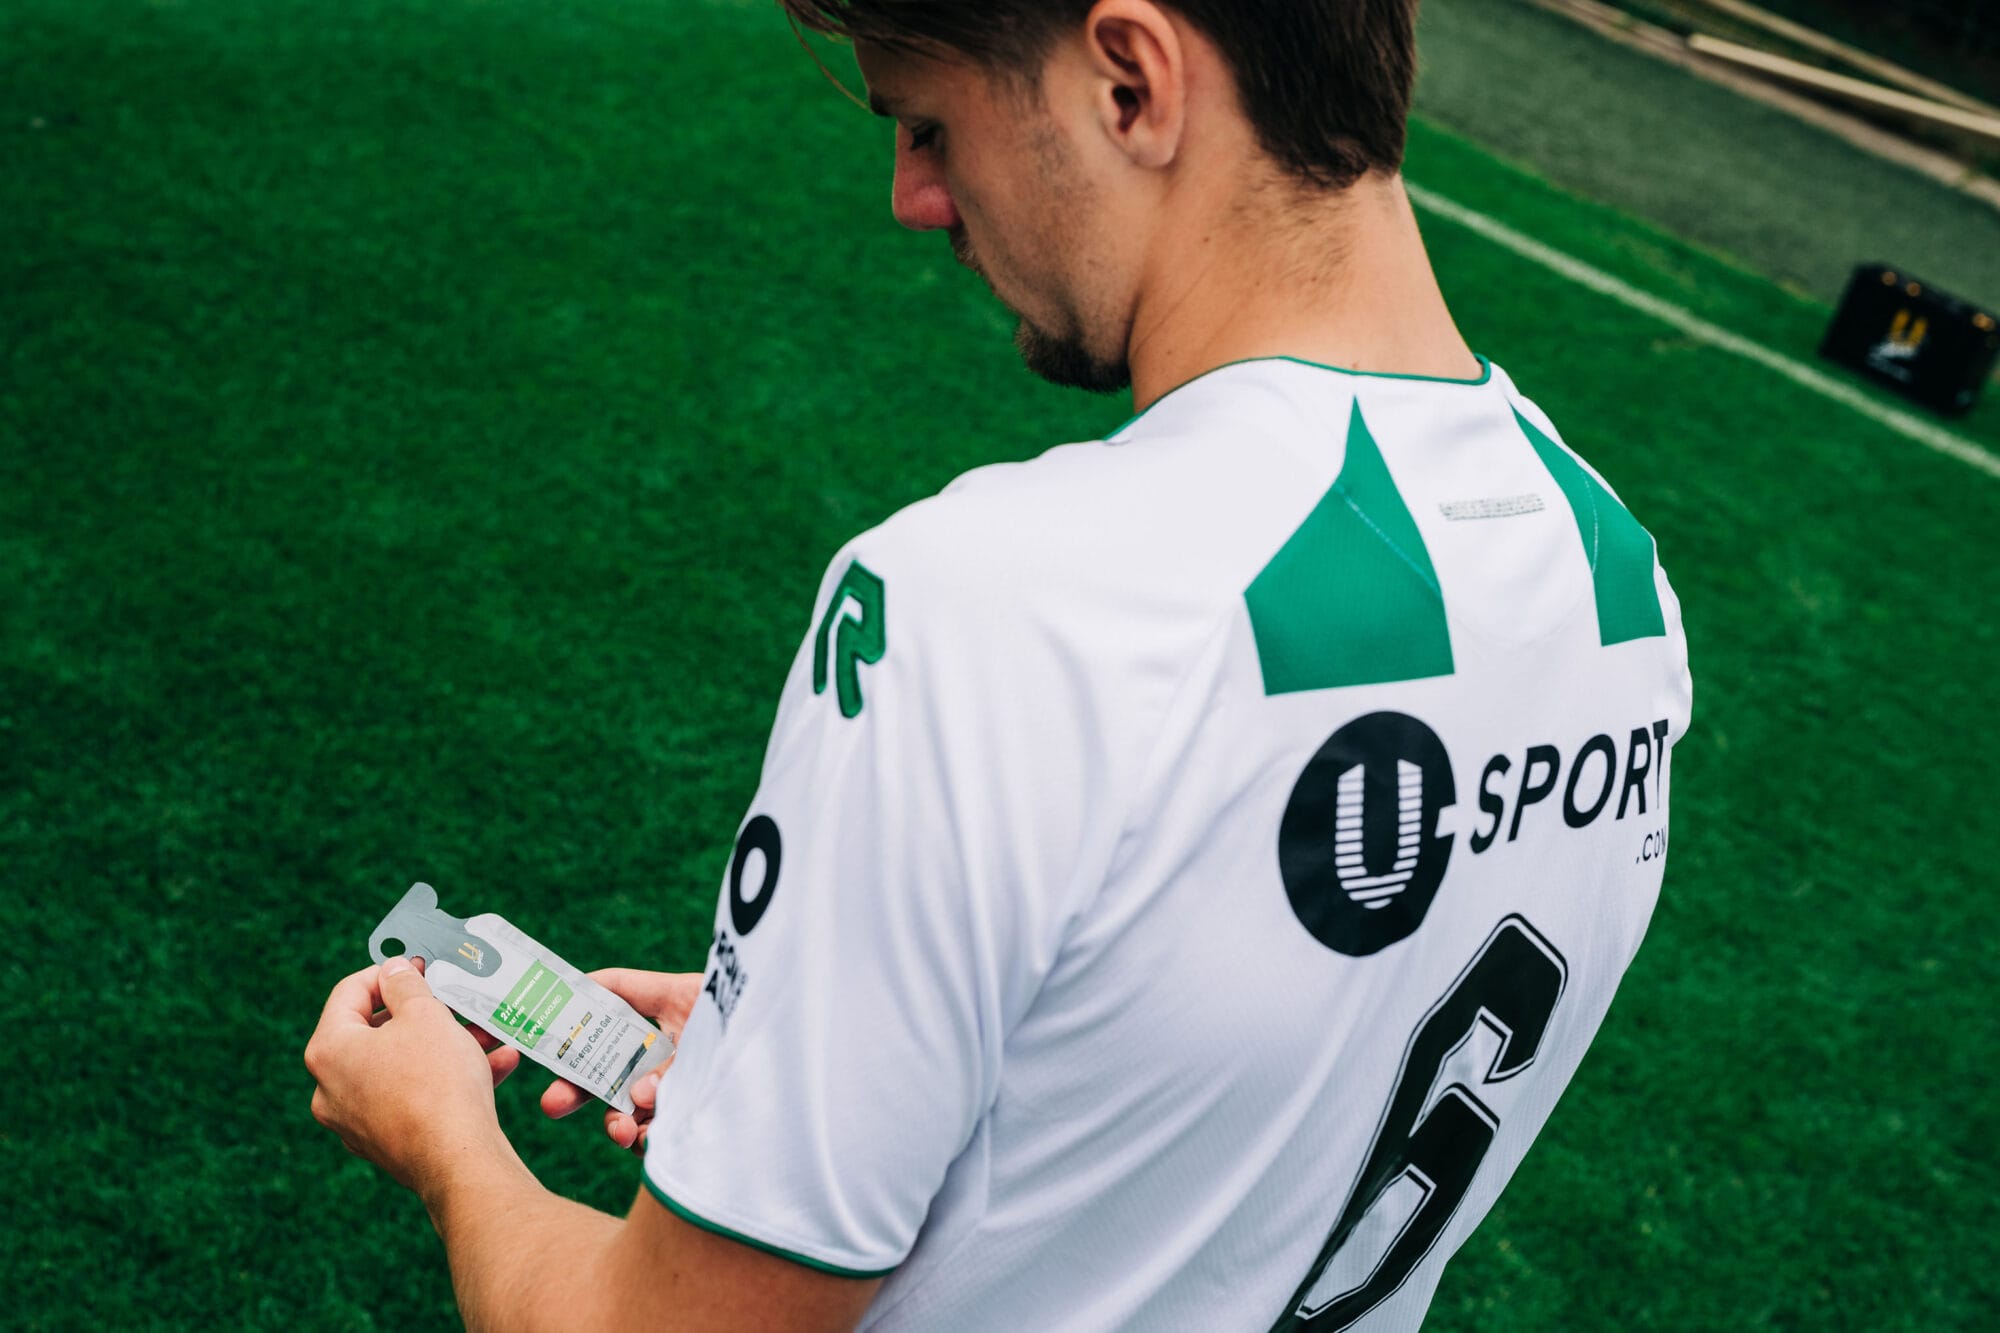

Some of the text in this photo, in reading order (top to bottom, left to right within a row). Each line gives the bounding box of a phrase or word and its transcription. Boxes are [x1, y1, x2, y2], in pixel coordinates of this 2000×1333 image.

[527, 1018, 544, 1040] APPLE
[569, 1014, 612, 1069] Energy Carb Gel
[1266, 912, 1568, 1333] 6
